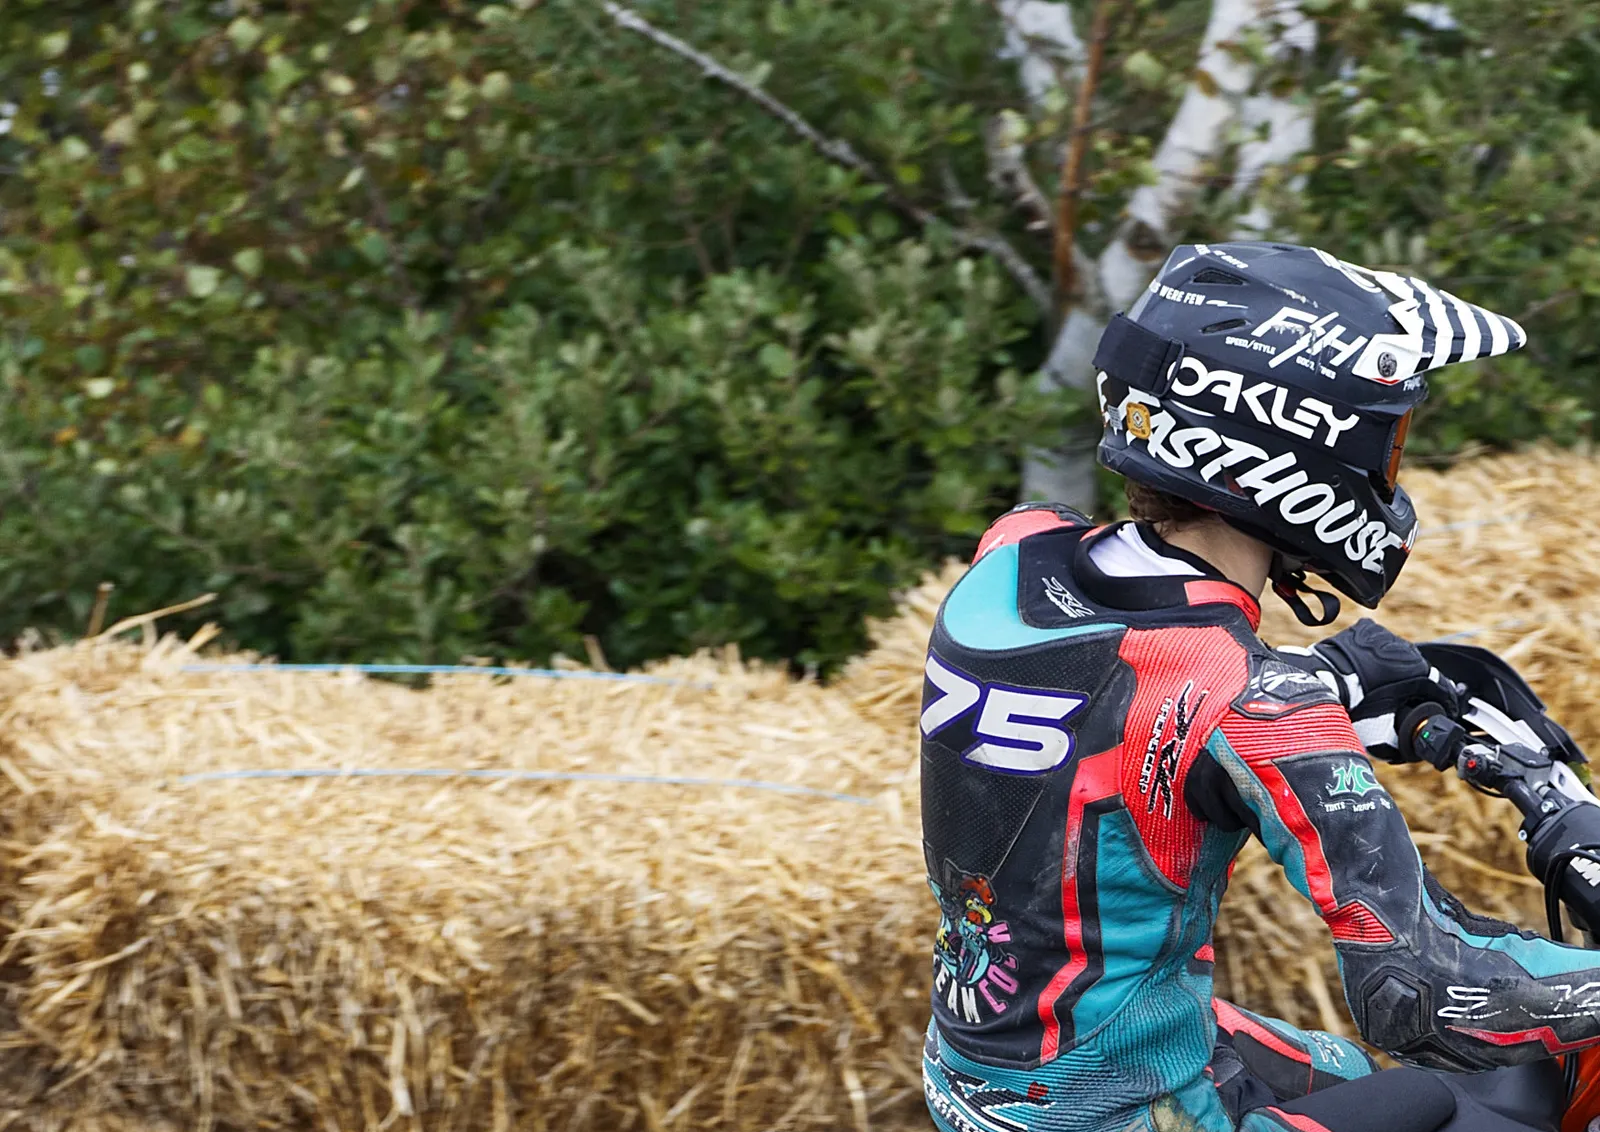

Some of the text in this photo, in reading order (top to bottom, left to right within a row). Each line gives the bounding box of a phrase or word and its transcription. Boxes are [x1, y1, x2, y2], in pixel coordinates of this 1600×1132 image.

[1167, 356, 1359, 447] OAKLEY
[1139, 697, 1174, 794] RACING CORP
